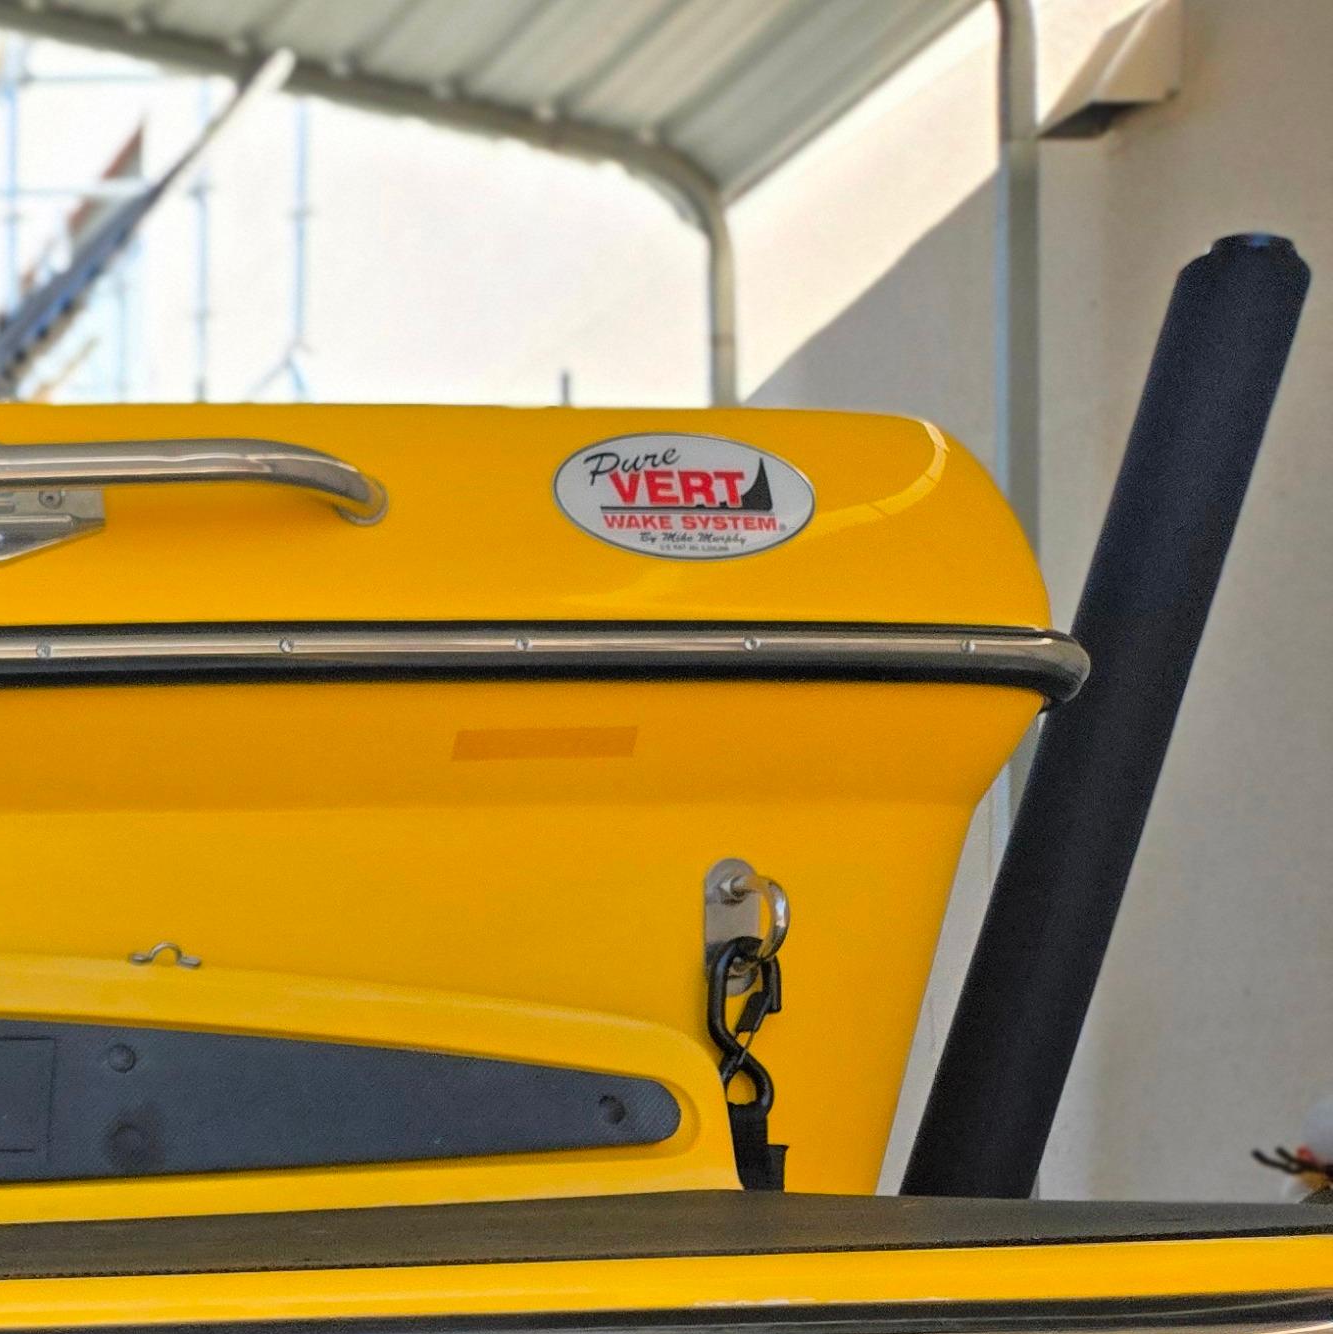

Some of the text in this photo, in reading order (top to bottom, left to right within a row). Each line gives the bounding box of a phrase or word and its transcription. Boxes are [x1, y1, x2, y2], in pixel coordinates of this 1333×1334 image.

[584, 447, 680, 486] Pure
[609, 470, 744, 506] VERT
[604, 514, 778, 530] WAKE SYSTEM
[662, 531, 693, 543] Mike
